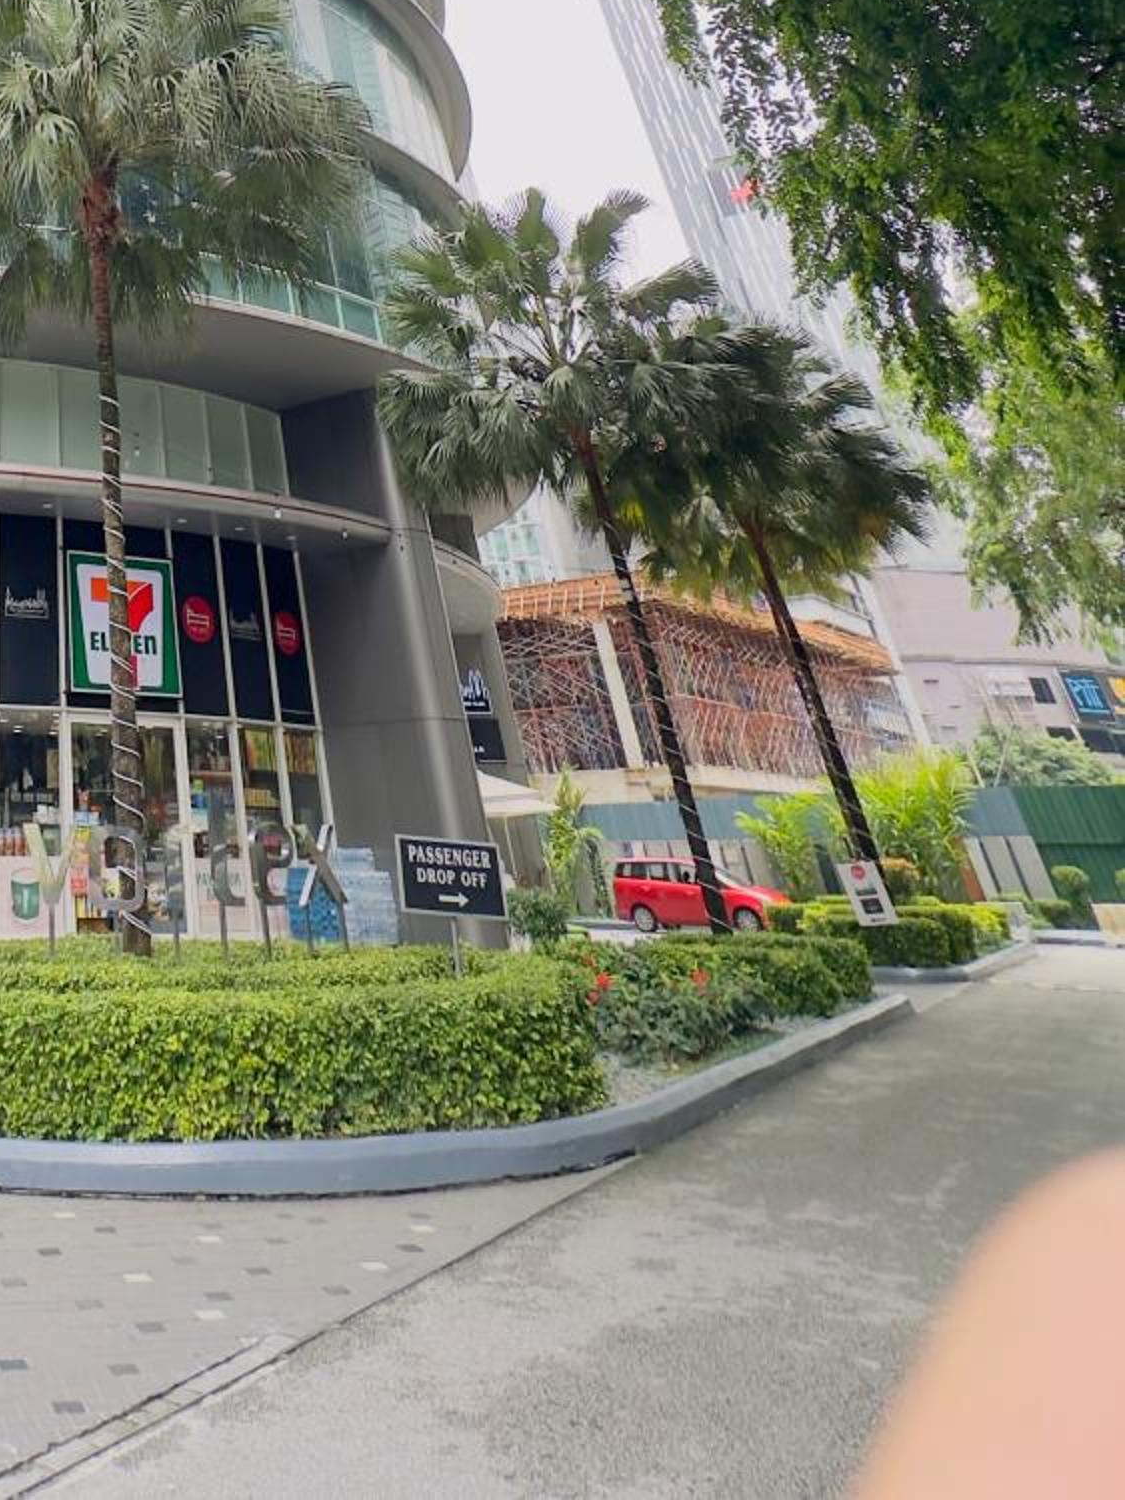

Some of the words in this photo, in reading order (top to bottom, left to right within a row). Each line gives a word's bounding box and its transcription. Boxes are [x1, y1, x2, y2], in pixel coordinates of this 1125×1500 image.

[90, 630, 158, 655] ELEn
[408, 845, 491, 869] PASSENGER
[416, 867, 456, 885] DROP
[460, 871, 488, 889] OFF
